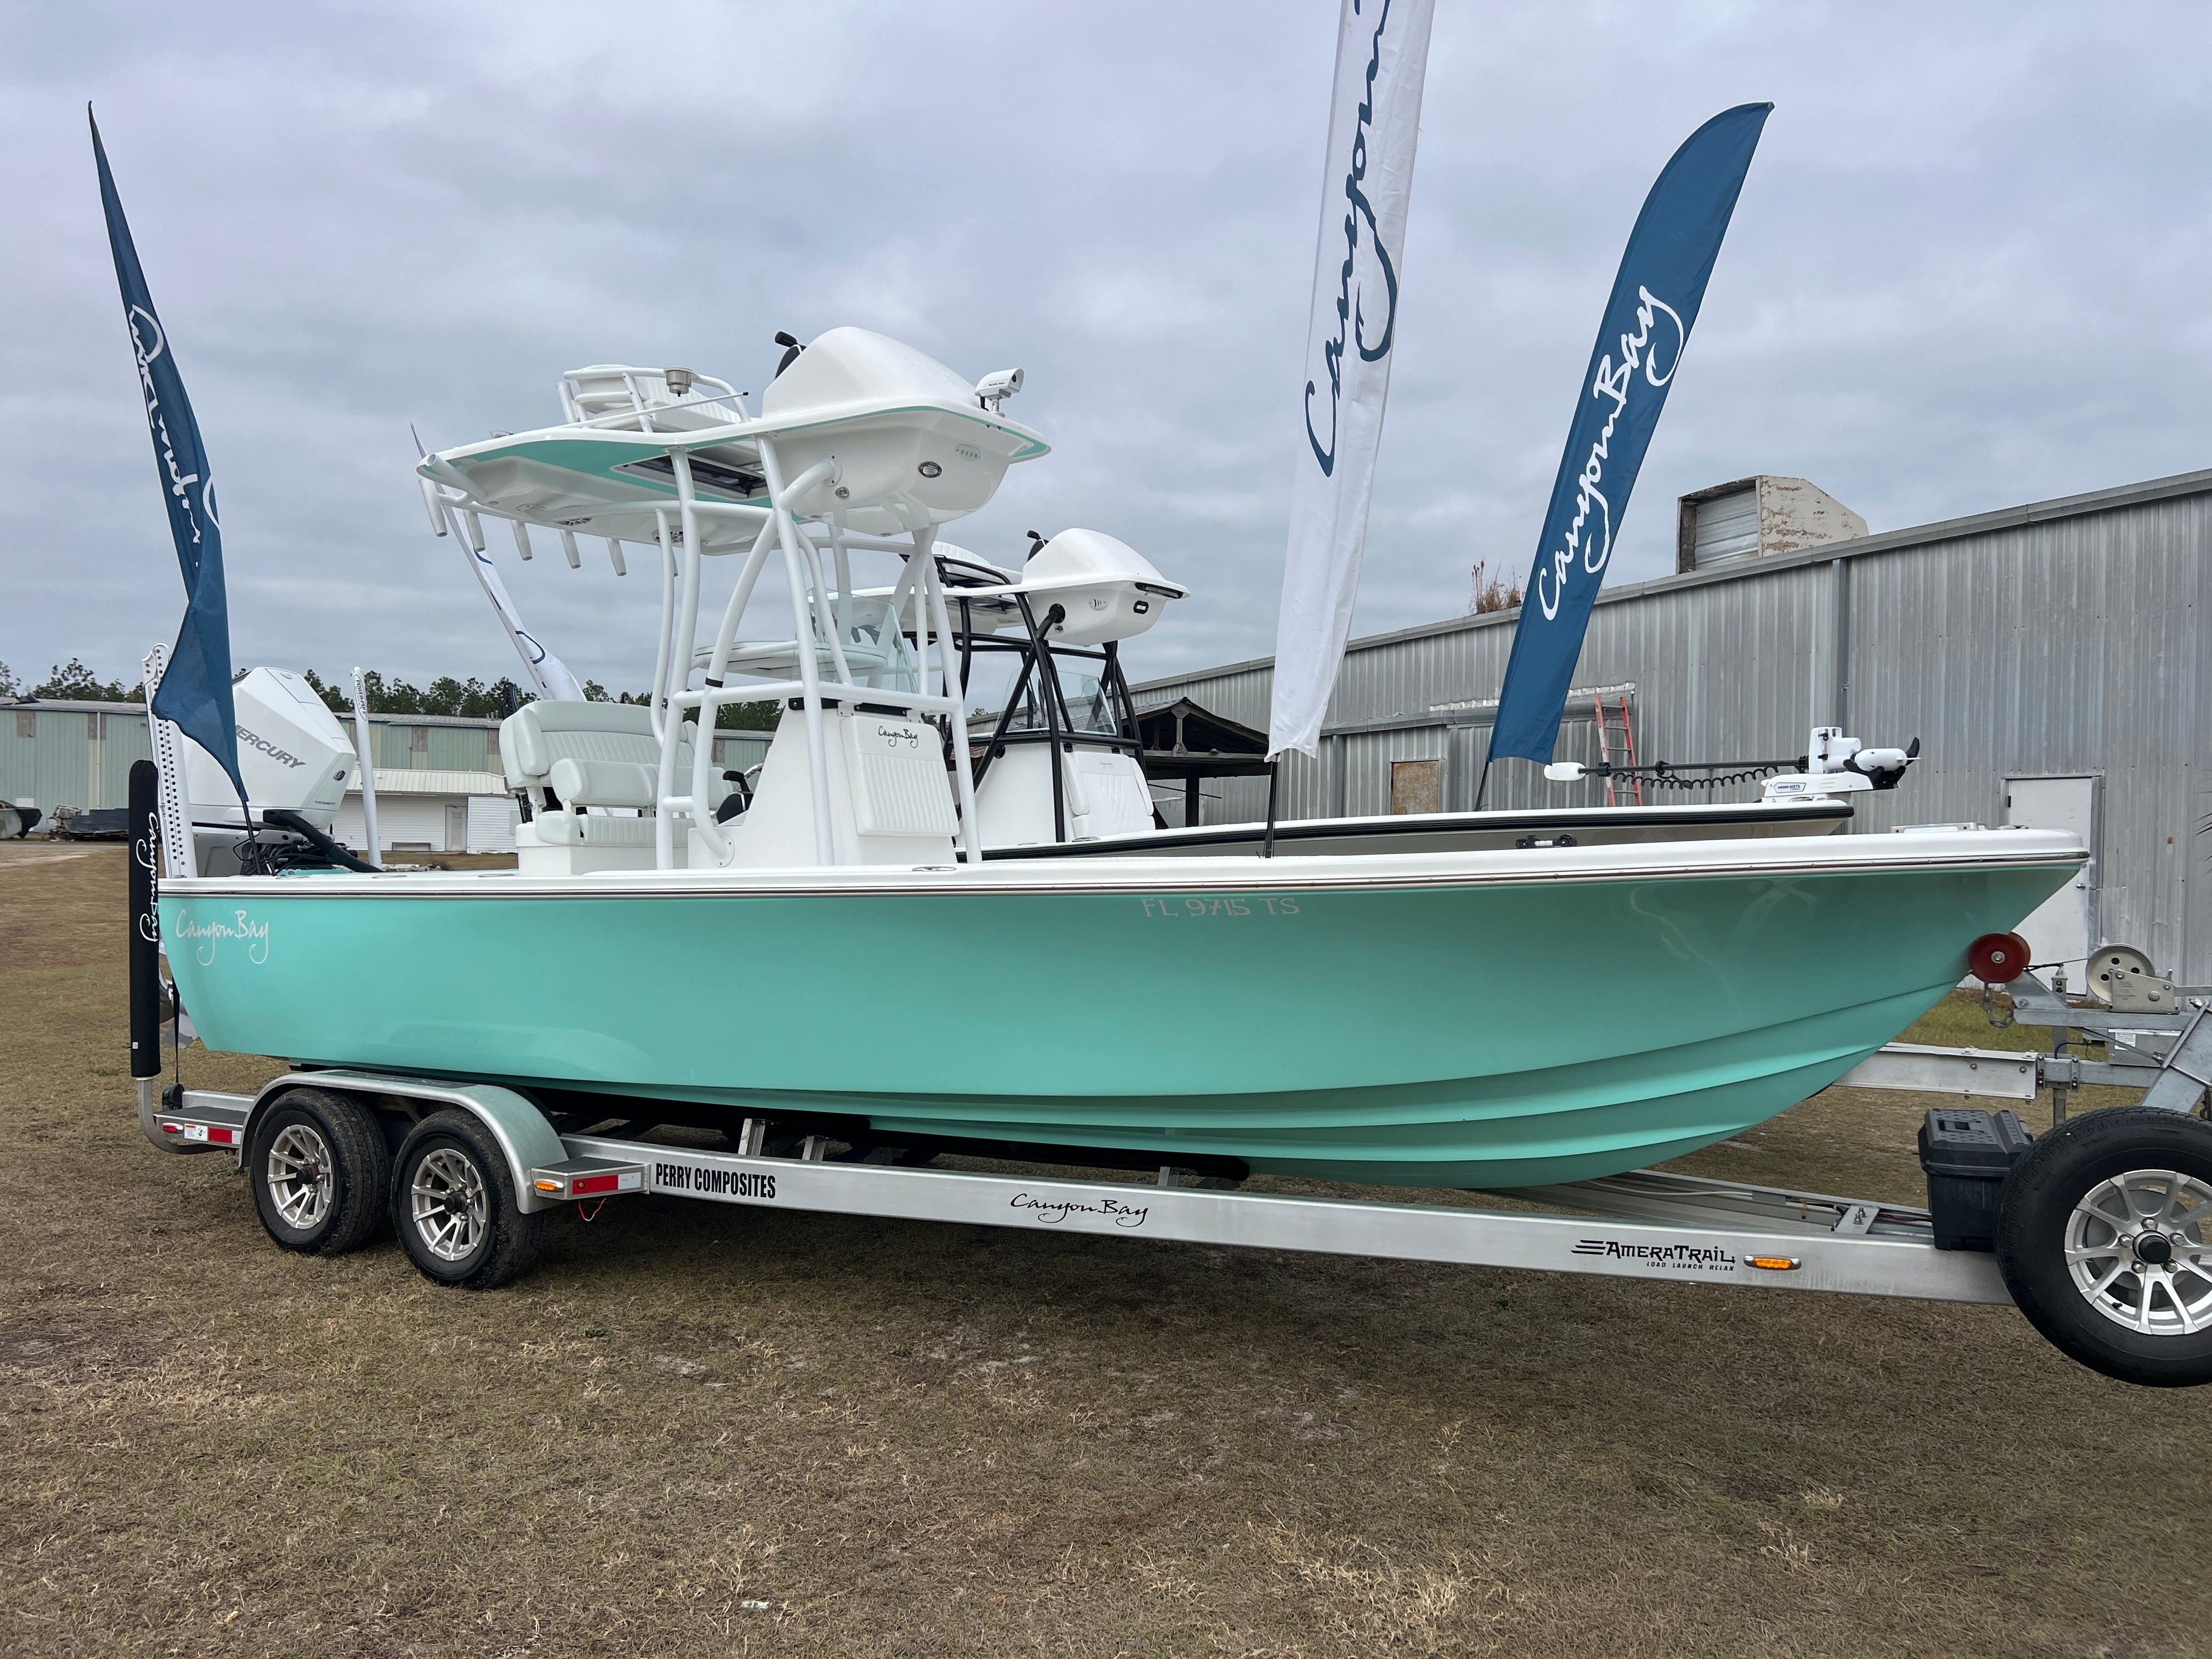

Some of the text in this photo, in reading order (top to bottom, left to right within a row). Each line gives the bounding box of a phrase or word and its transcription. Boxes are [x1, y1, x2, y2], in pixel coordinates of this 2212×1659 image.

[1141, 896, 1300, 917] FL 9715 TS
[656, 1163, 776, 1199] PERRY COMPOSITES
